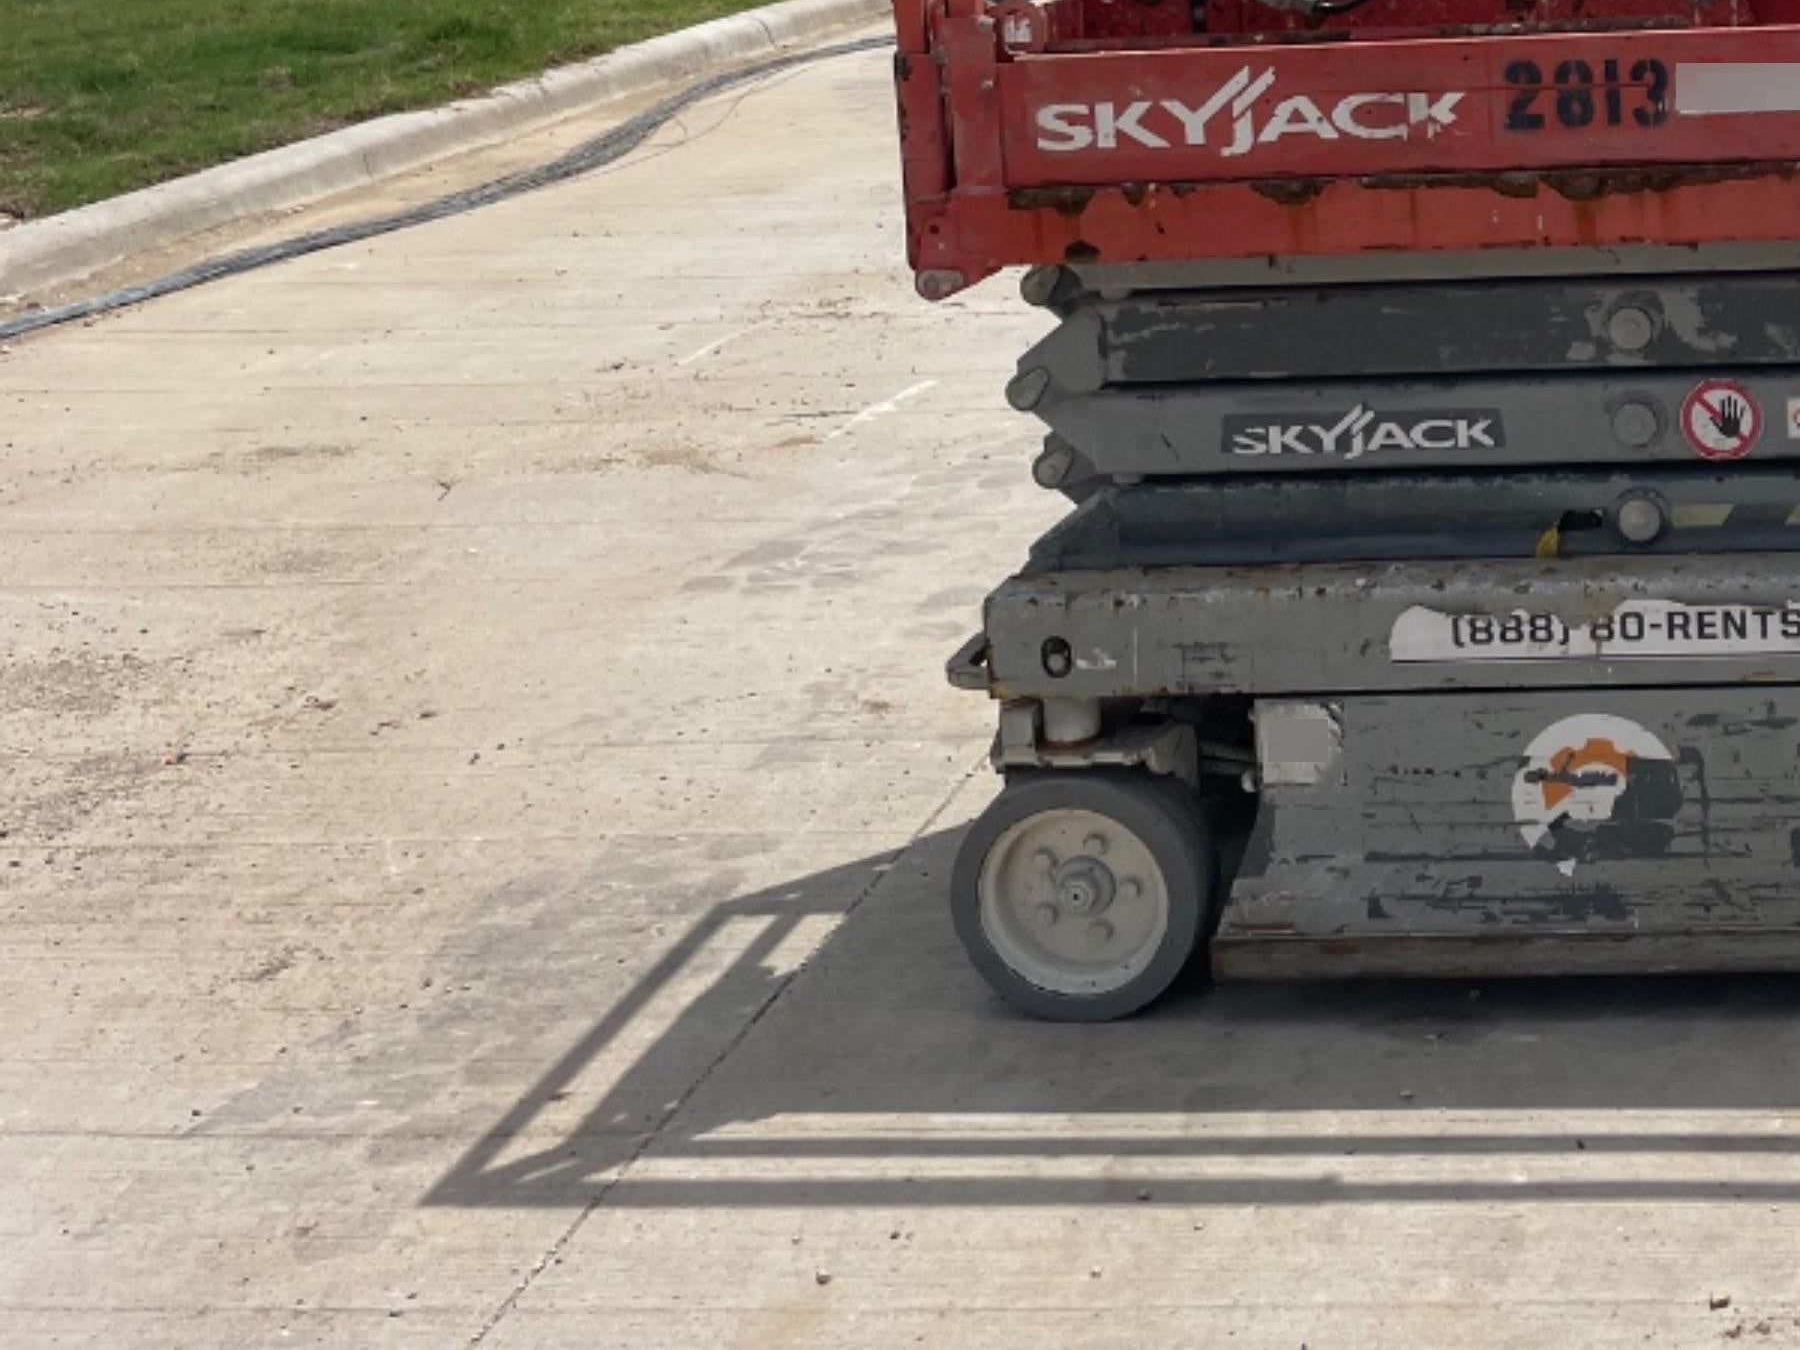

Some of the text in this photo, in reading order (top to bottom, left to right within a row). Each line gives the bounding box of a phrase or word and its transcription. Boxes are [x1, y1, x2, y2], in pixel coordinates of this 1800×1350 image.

[1035, 65, 1467, 158] SKYJACK
[1502, 57, 1670, 132] 2813
[1231, 401, 1496, 460] SKYJACK
